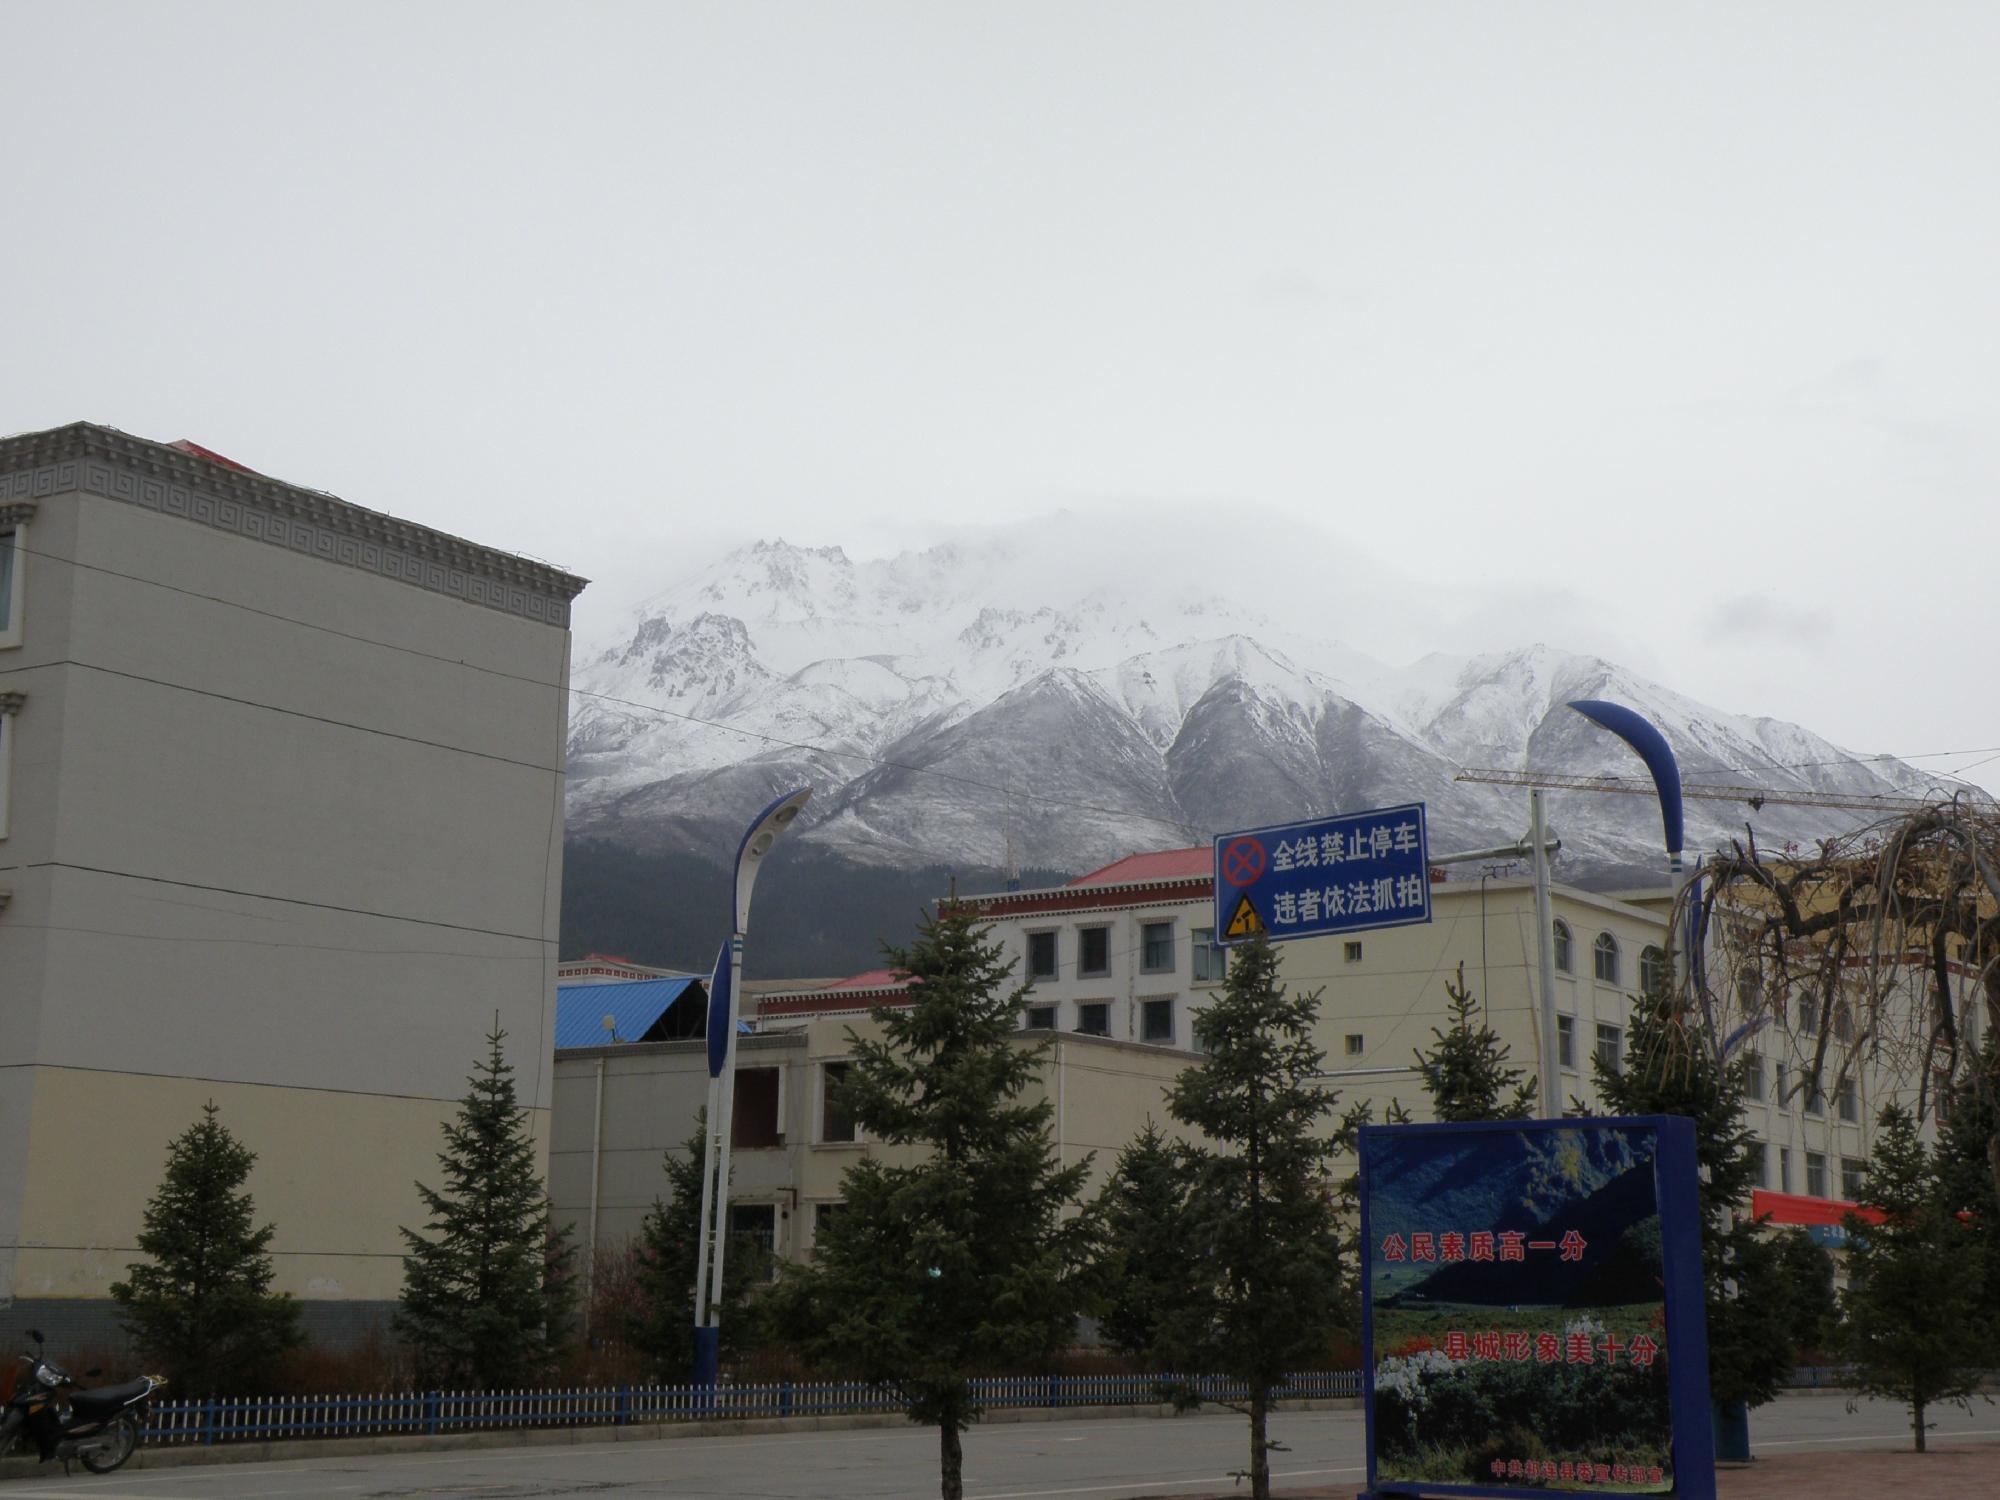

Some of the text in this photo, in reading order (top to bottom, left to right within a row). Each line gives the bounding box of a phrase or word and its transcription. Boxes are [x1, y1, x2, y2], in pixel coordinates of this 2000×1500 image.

[1273, 822, 1419, 872] 全线禁止停车
[1273, 874, 1423, 925] 违者依法抓拍
[1382, 1230, 1587, 1262] 公民素质高一分
[1444, 1331, 1659, 1366] 县城形象美十分
